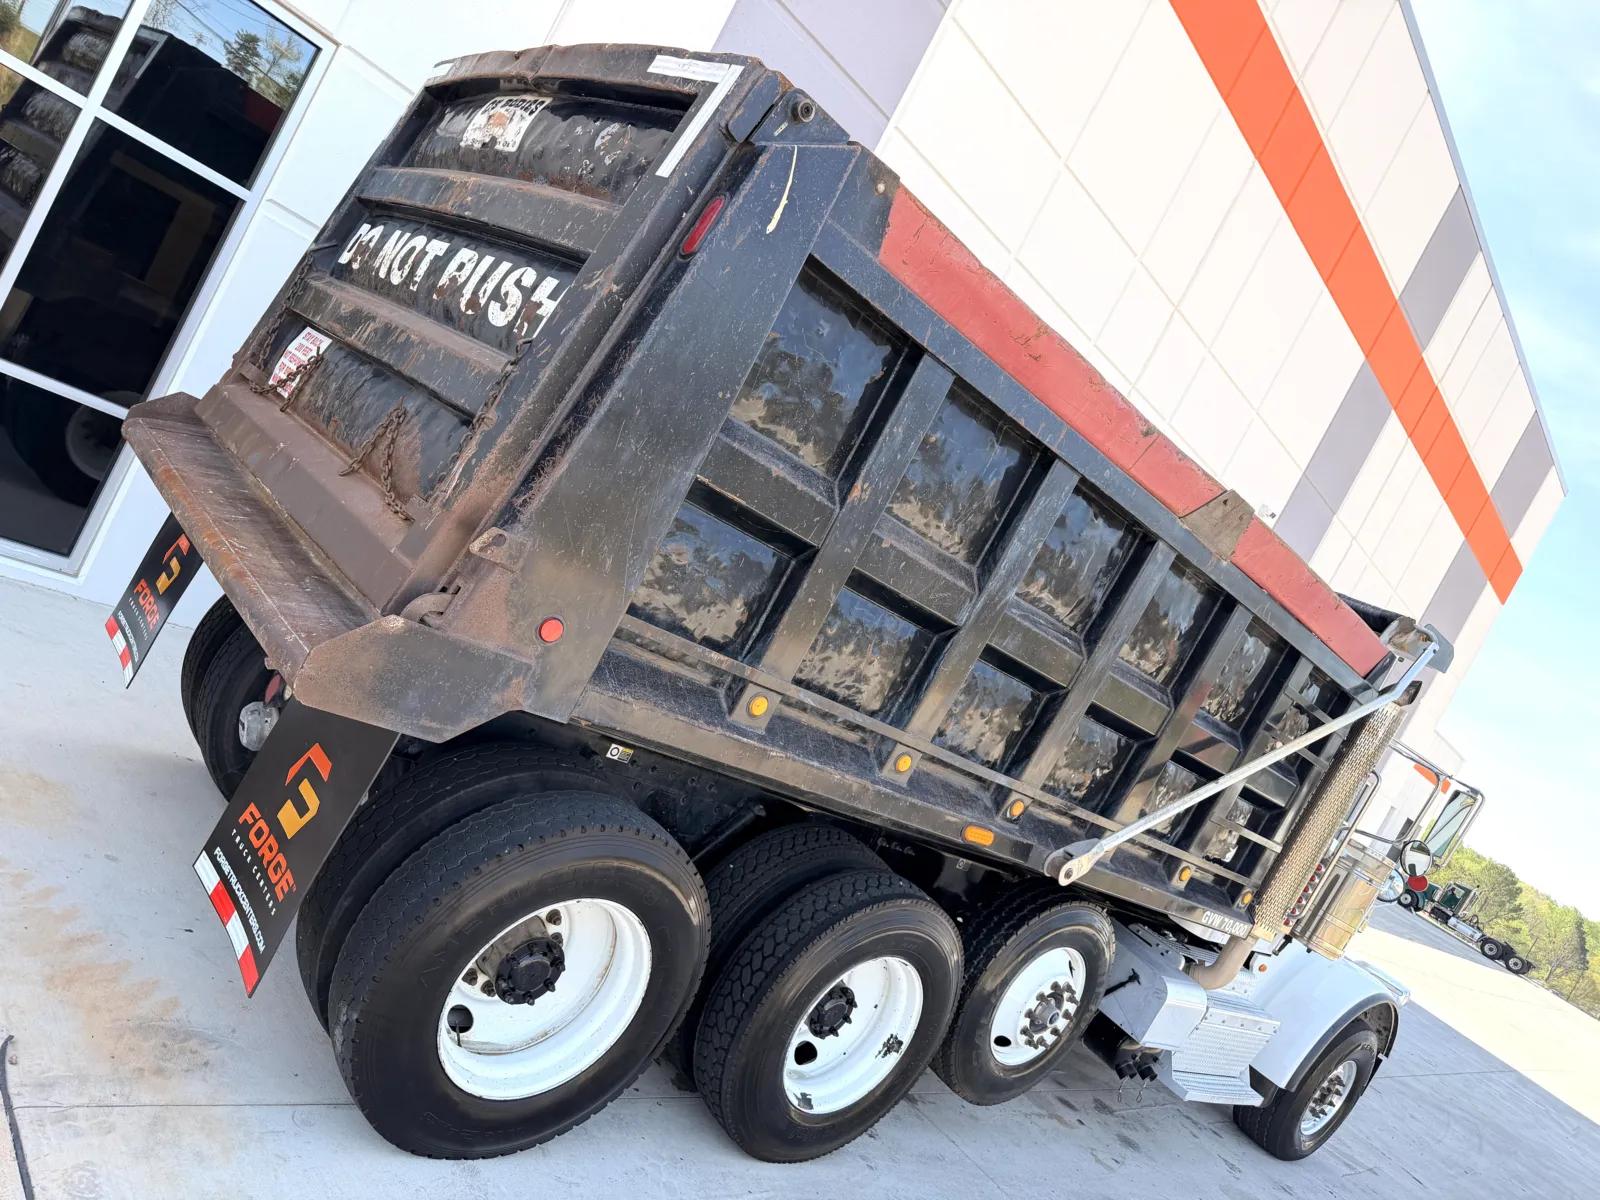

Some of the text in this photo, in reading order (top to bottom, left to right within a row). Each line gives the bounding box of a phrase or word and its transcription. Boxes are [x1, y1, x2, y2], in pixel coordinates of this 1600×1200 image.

[338, 223, 571, 338] DO NOT PUSH
[133, 578, 160, 631] FORGE
[231, 828, 276, 916] TRUCK CENTERS
[238, 802, 295, 902] FORGE
[213, 846, 266, 954] FORGETRUCKCENTERS.COM
[1201, 910, 1248, 937] GVW 70,000
